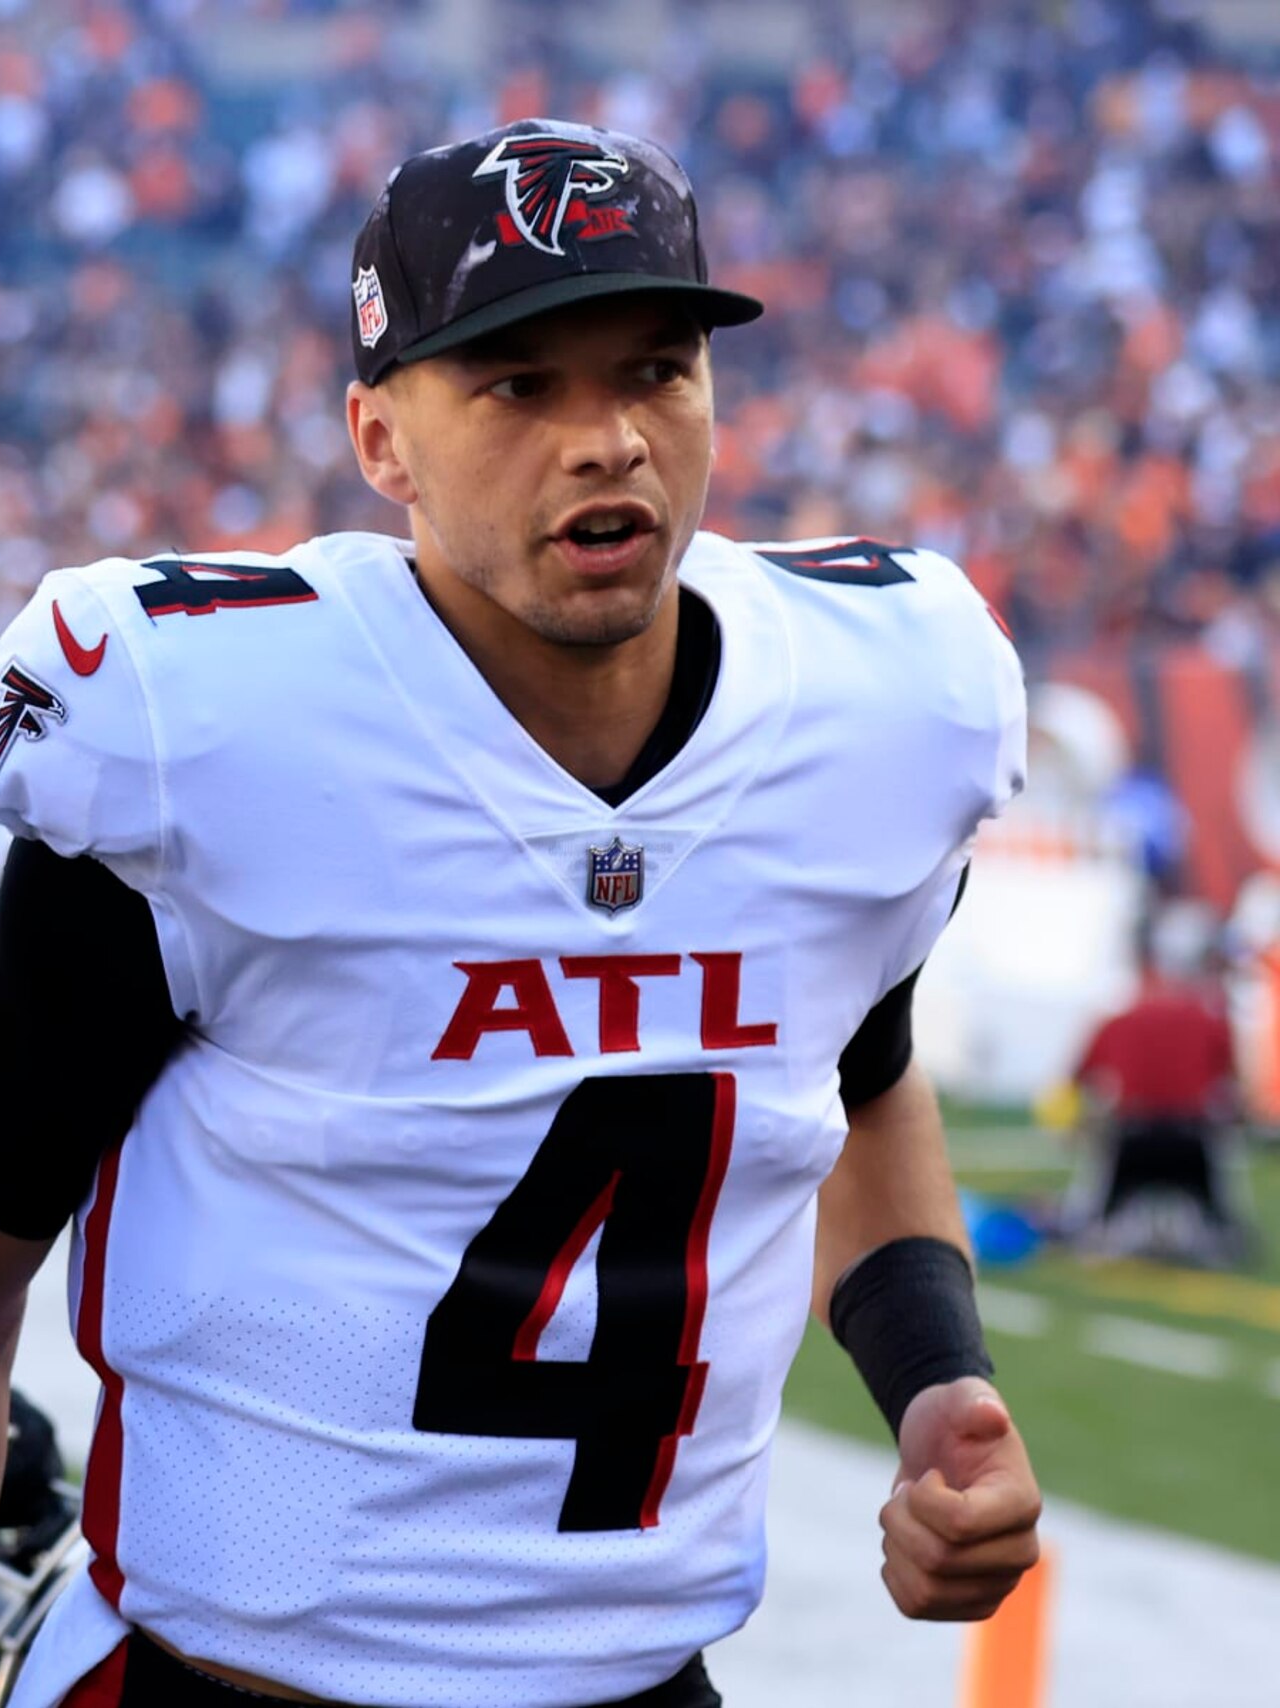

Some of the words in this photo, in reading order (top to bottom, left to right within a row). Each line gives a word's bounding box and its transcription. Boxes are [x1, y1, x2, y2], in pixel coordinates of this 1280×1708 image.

[360, 299, 381, 335] NFL
[133, 560, 319, 616] 4
[752, 536, 917, 588] 4
[595, 874, 635, 904] NFL
[431, 952, 778, 1060] ATL
[412, 1071, 736, 1533] 4
